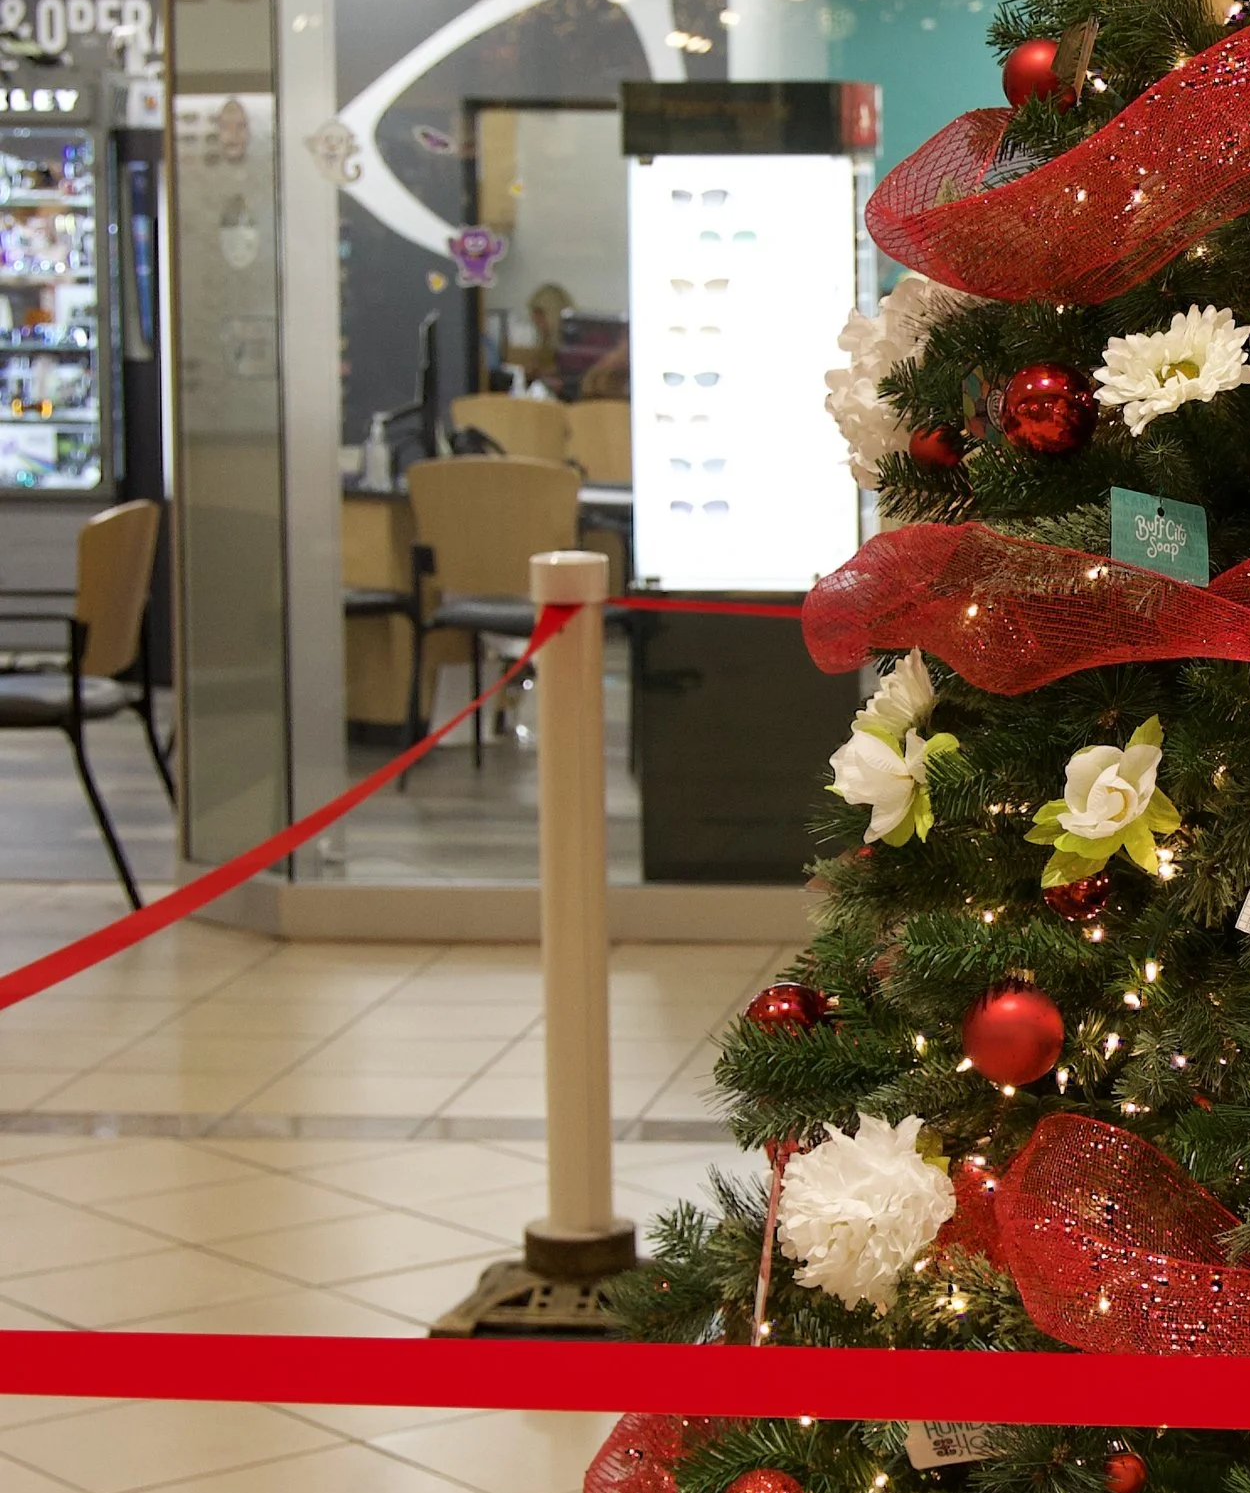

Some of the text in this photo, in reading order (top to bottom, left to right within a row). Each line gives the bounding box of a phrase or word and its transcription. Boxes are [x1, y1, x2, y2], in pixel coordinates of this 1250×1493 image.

[1134, 514, 1187, 546] Buff City
[1146, 535, 1179, 562] Soap
